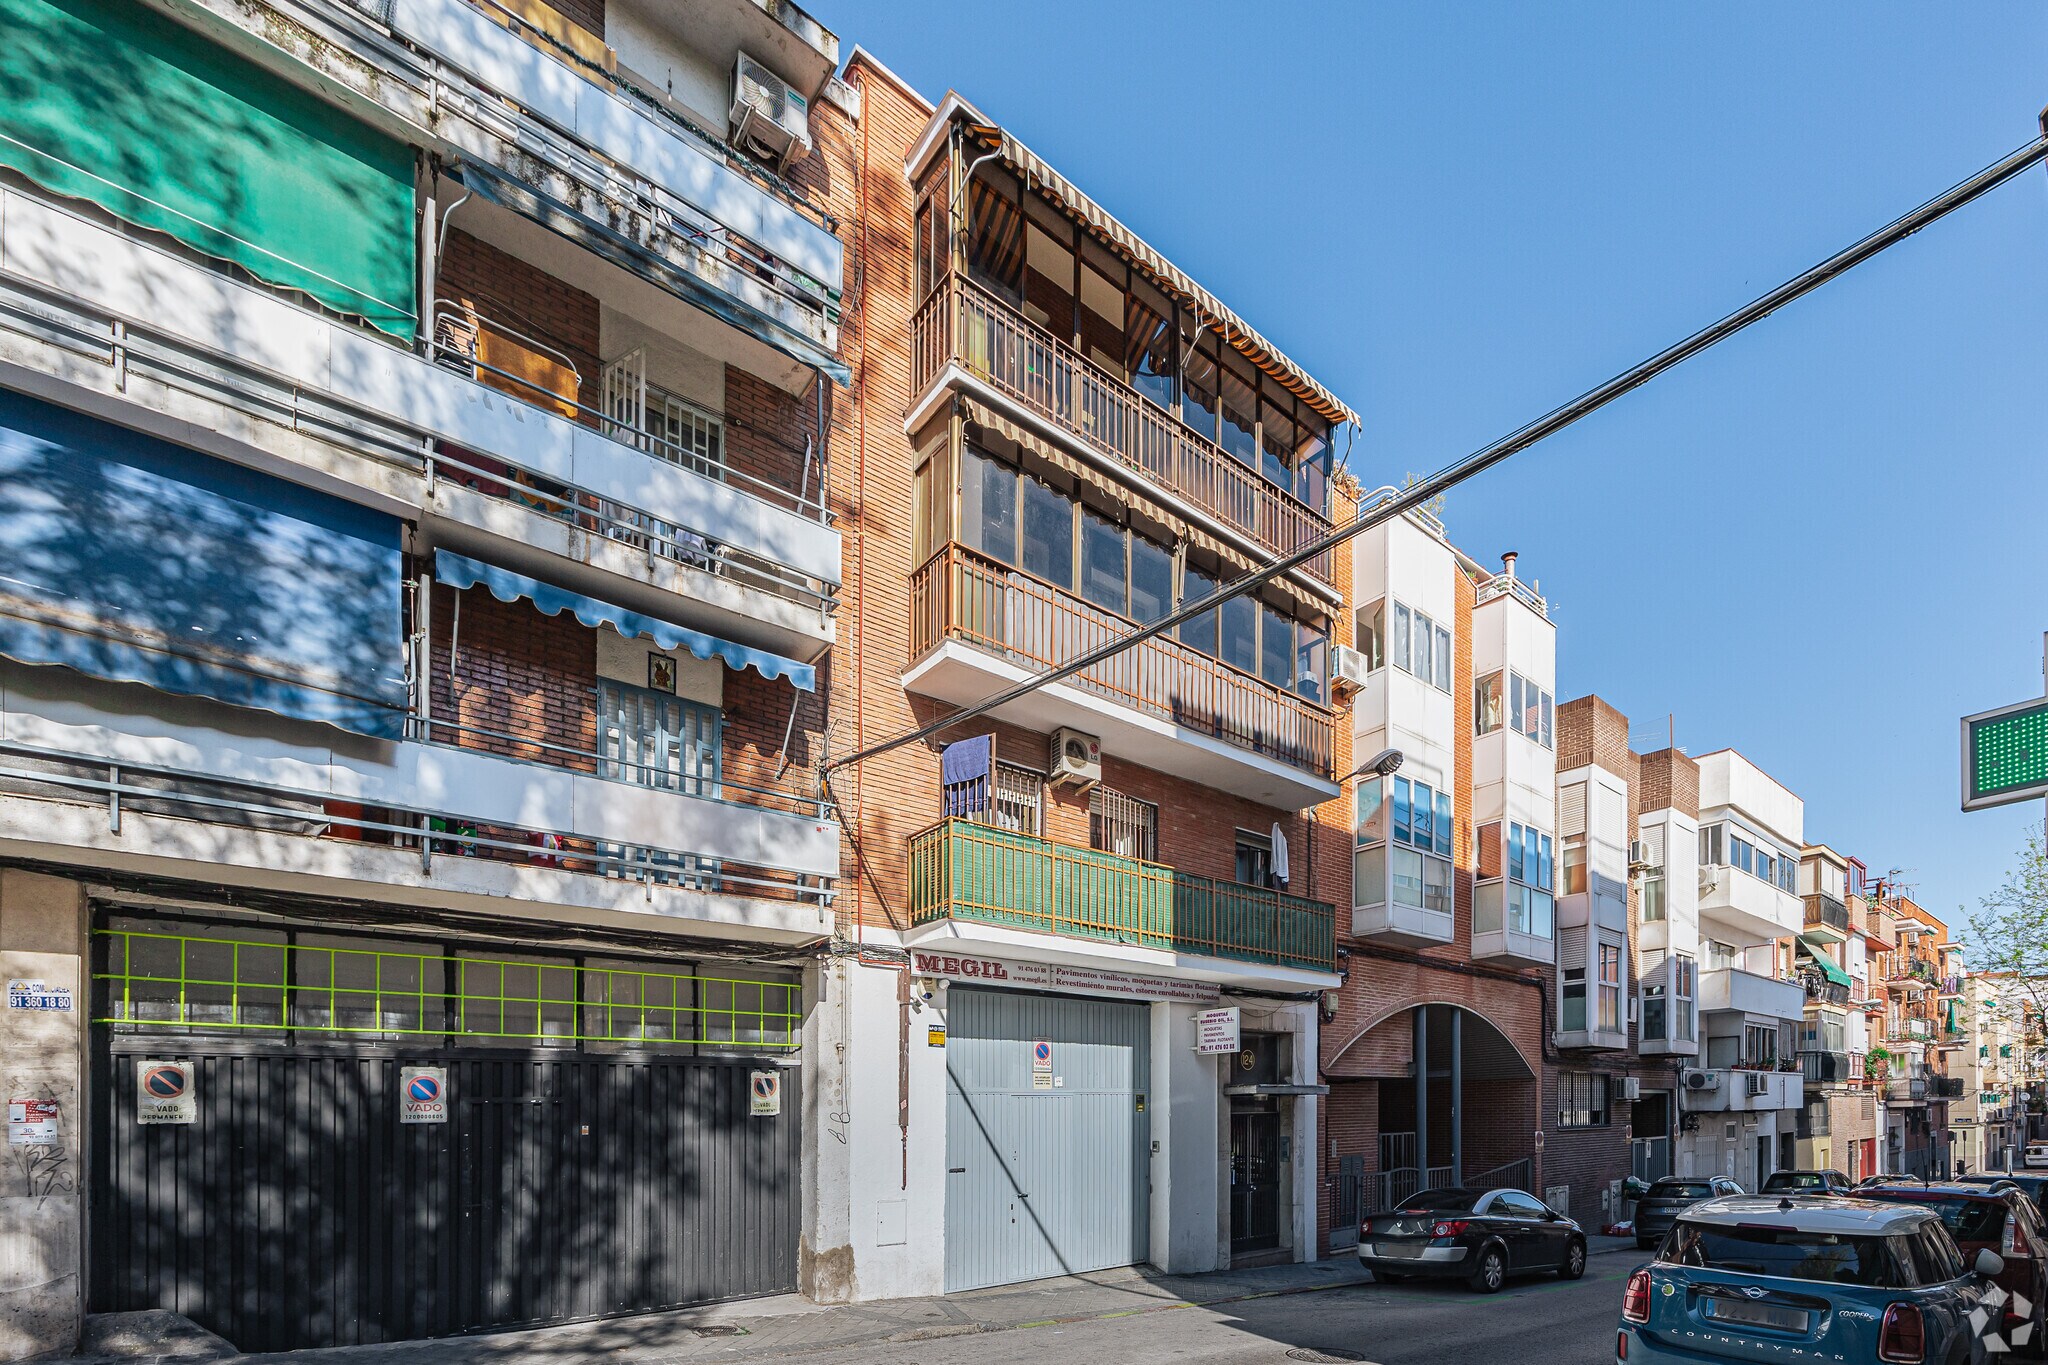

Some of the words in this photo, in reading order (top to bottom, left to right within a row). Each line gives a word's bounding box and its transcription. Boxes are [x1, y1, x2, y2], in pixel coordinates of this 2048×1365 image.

[915, 953, 1008, 980] MEGIL
[1013, 976, 1047, 984] www.megil.es
[1056, 967, 1098, 979] Pavimentos
[1099, 973, 1130, 983] vinílicos,
[1132, 977, 1163, 986] moquetas
[1170, 981, 1193, 989] tarimas
[1194, 983, 1220, 992] flotantes
[1056, 978, 1105, 990] Revestimiento
[1106, 985, 1134, 993] murales,
[1158, 989, 1190, 998] enrollables
[1196, 992, 1220, 1000] felpudos
[11, 996, 22, 1007] 91
[25, 997, 42, 1007] 360
[45, 997, 56, 1008] 18
[58, 997, 70, 1008] 80
[1242, 1054, 1253, 1066] 124
[156, 1105, 179, 1113] VADO
[406, 1103, 443, 1112] VADO
[1838, 1310, 1869, 1319] COOPER
[1671, 1328, 1844, 1360] COUNTRYMAN
